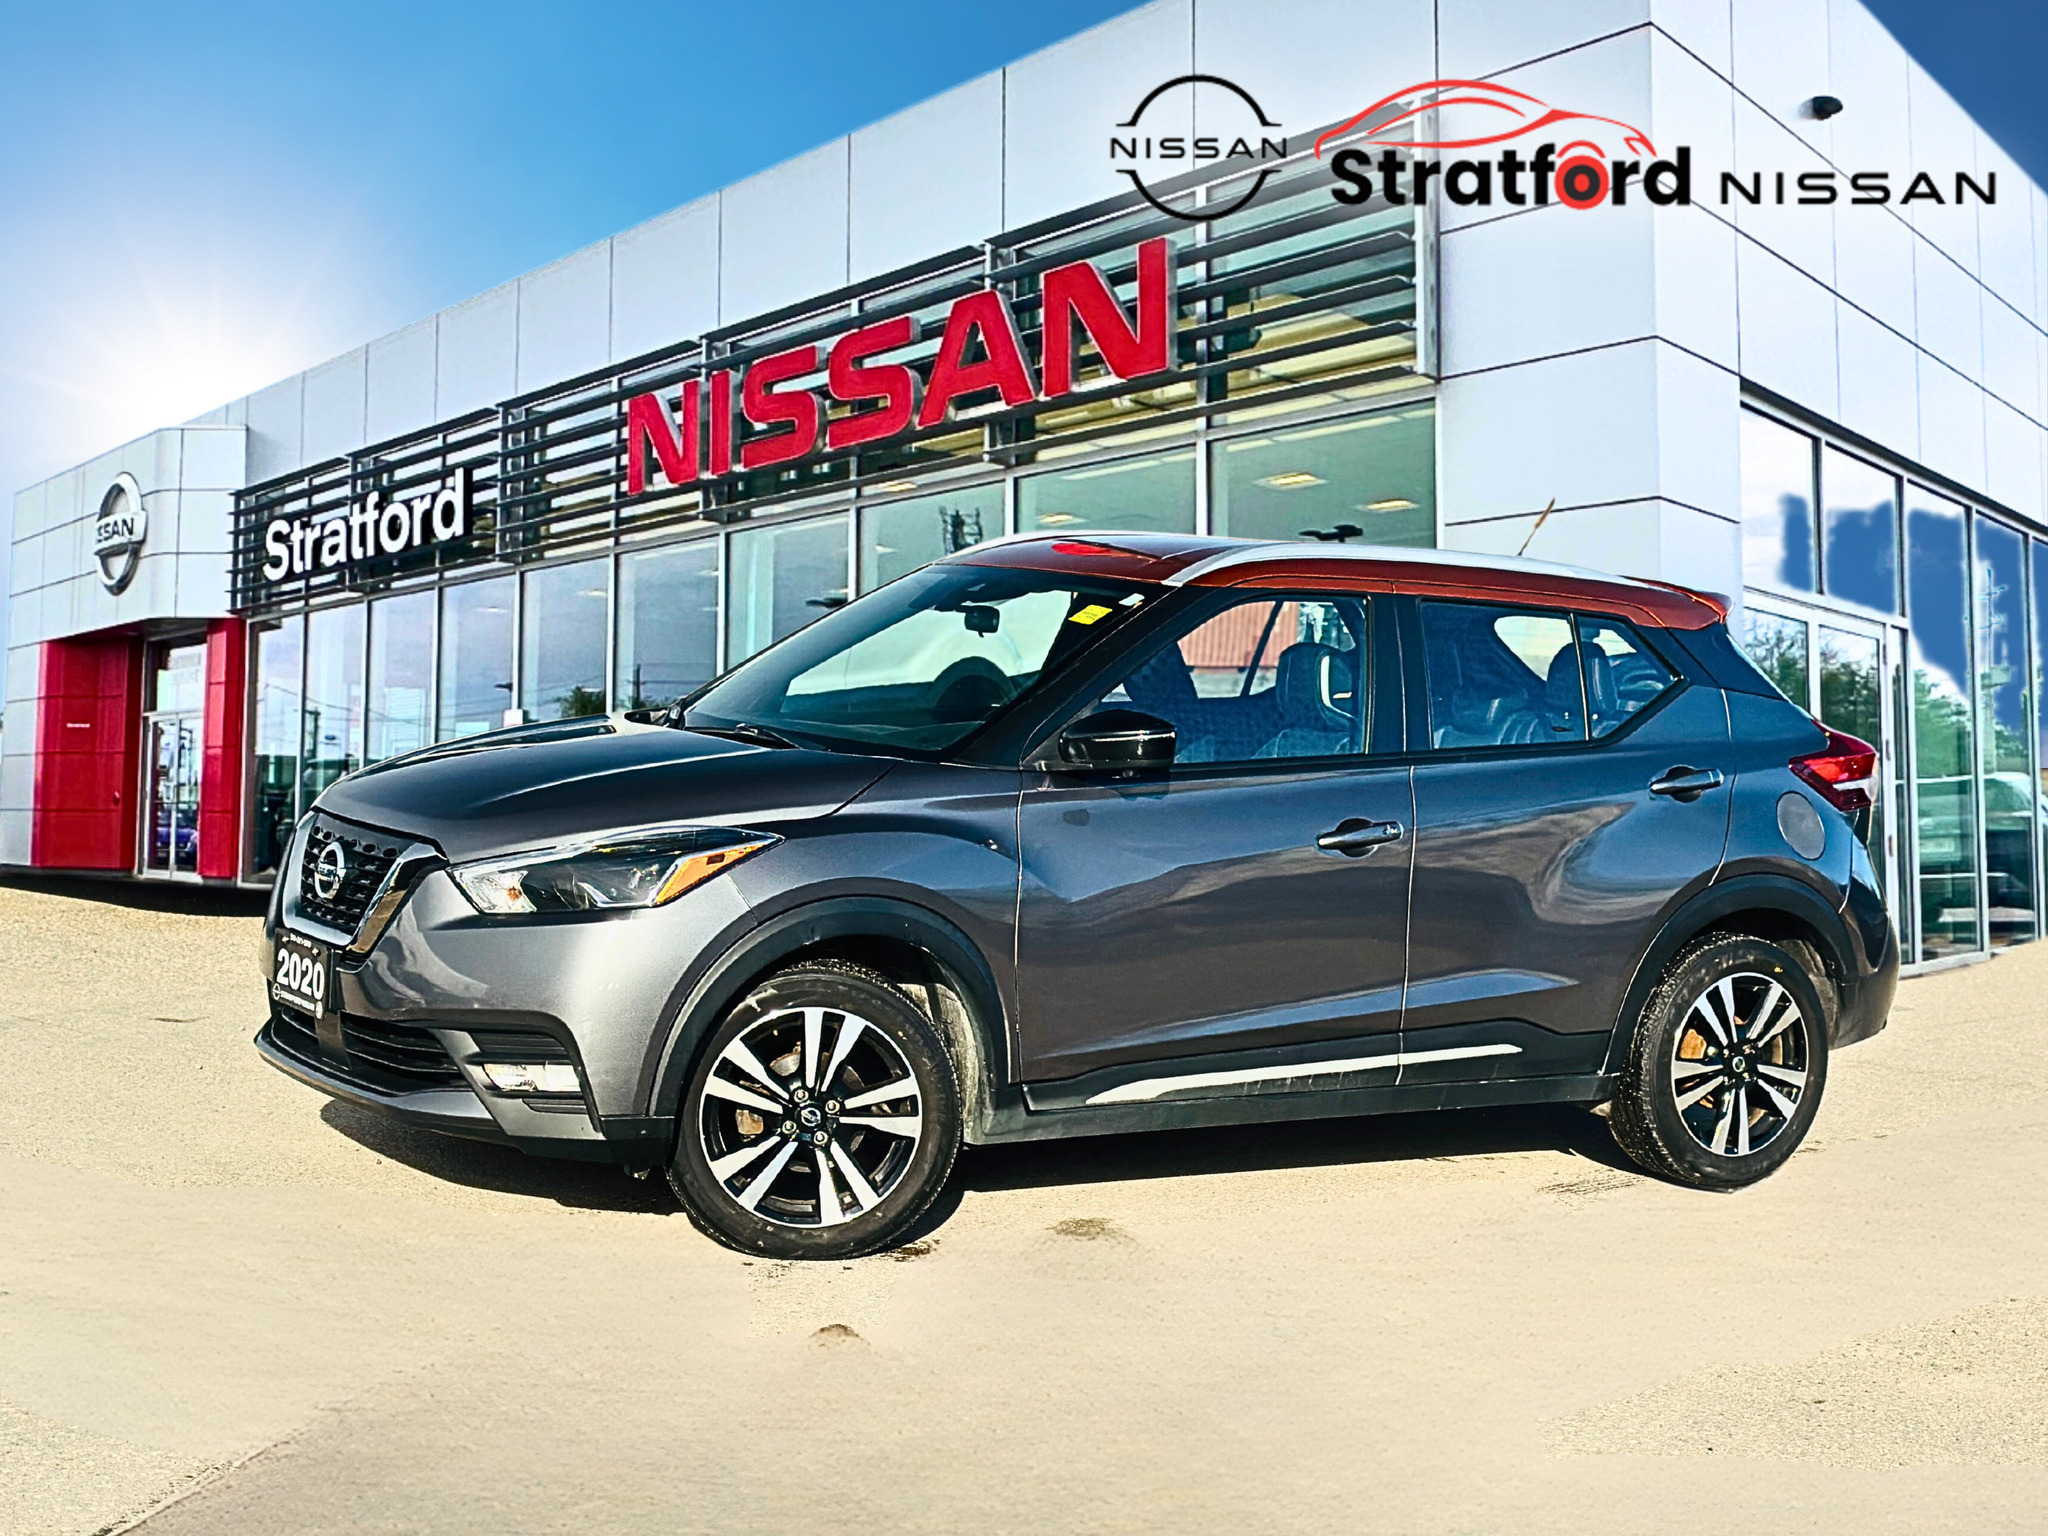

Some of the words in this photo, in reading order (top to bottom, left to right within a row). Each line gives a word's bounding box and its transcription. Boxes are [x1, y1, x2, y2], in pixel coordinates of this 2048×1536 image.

[627, 237, 1172, 496] NISSAN
[263, 467, 465, 582] Stratford
[276, 947, 325, 1000] 2020
